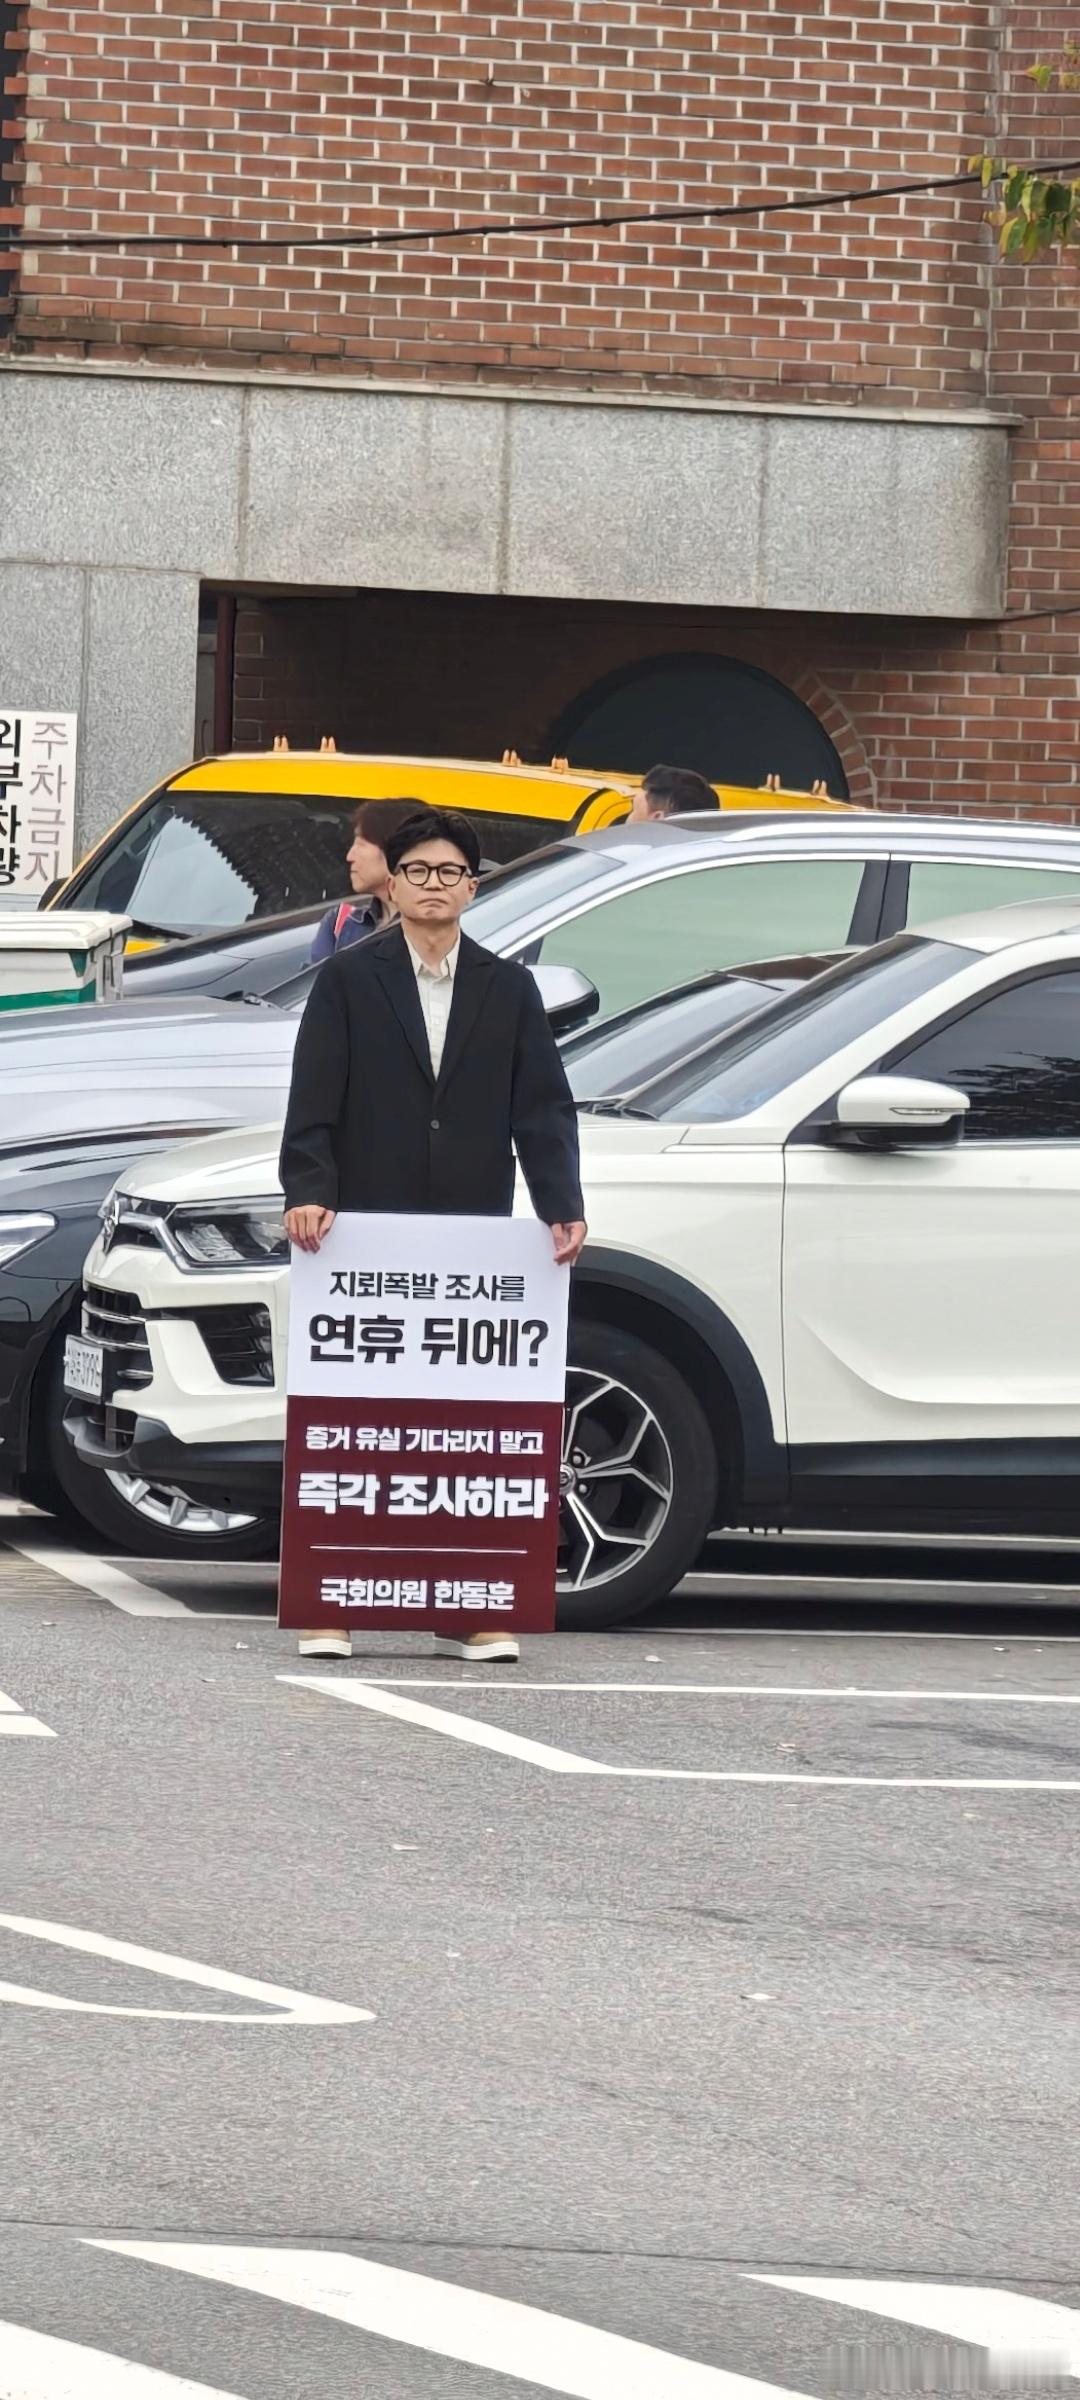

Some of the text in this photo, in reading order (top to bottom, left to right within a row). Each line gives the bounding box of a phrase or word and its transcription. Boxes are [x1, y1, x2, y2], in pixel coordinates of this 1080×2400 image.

[24, 721, 69, 882] 주차금지
[329, 1271, 525, 1302] 지뢰폭발 조사를
[309, 1314, 549, 1367] 연휴 뒤에?
[305, 1425, 544, 1455] 증거 유실 기다리지 말고
[298, 1472, 549, 1519] 즉각 조사하라
[320, 1577, 515, 1610] 국회의원 한동훈
